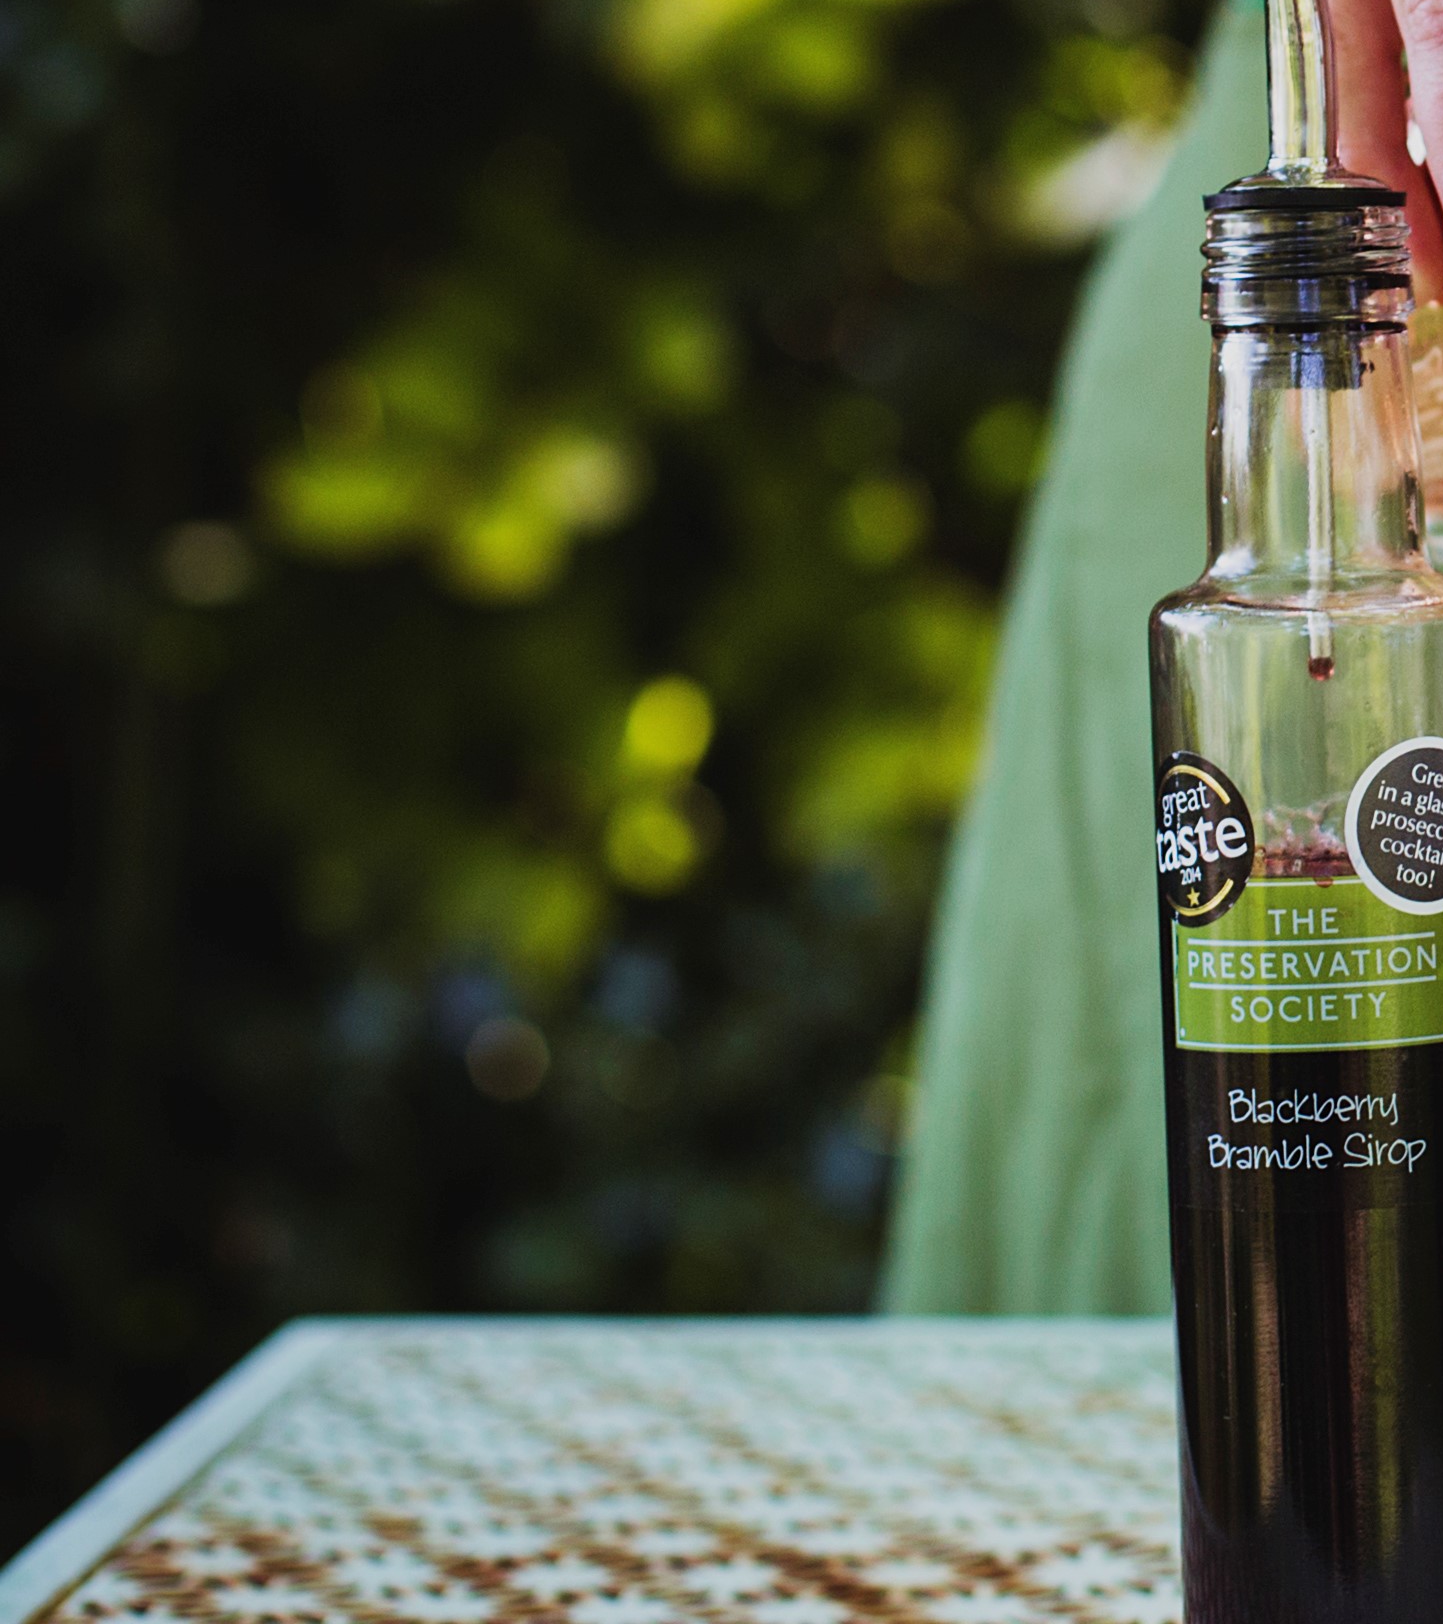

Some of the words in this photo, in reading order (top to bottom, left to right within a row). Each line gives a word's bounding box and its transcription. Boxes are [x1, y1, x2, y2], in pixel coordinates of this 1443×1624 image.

[1162, 781, 1210, 827] great
[1377, 779, 1397, 803] in
[1401, 791, 1412, 807] a
[1156, 816, 1248, 874] taste
[1179, 866, 1203, 886] 2014
[1396, 864, 1436, 889] too!
[1267, 907, 1339, 935] THE
[1188, 944, 1437, 979] PRESERVATION
[1230, 991, 1386, 1024] SOCIETY
[1227, 1088, 1400, 1126] Blackberry
[1206, 1133, 1333, 1170] Bramble
[1342, 1132, 1428, 1173] Sirop
